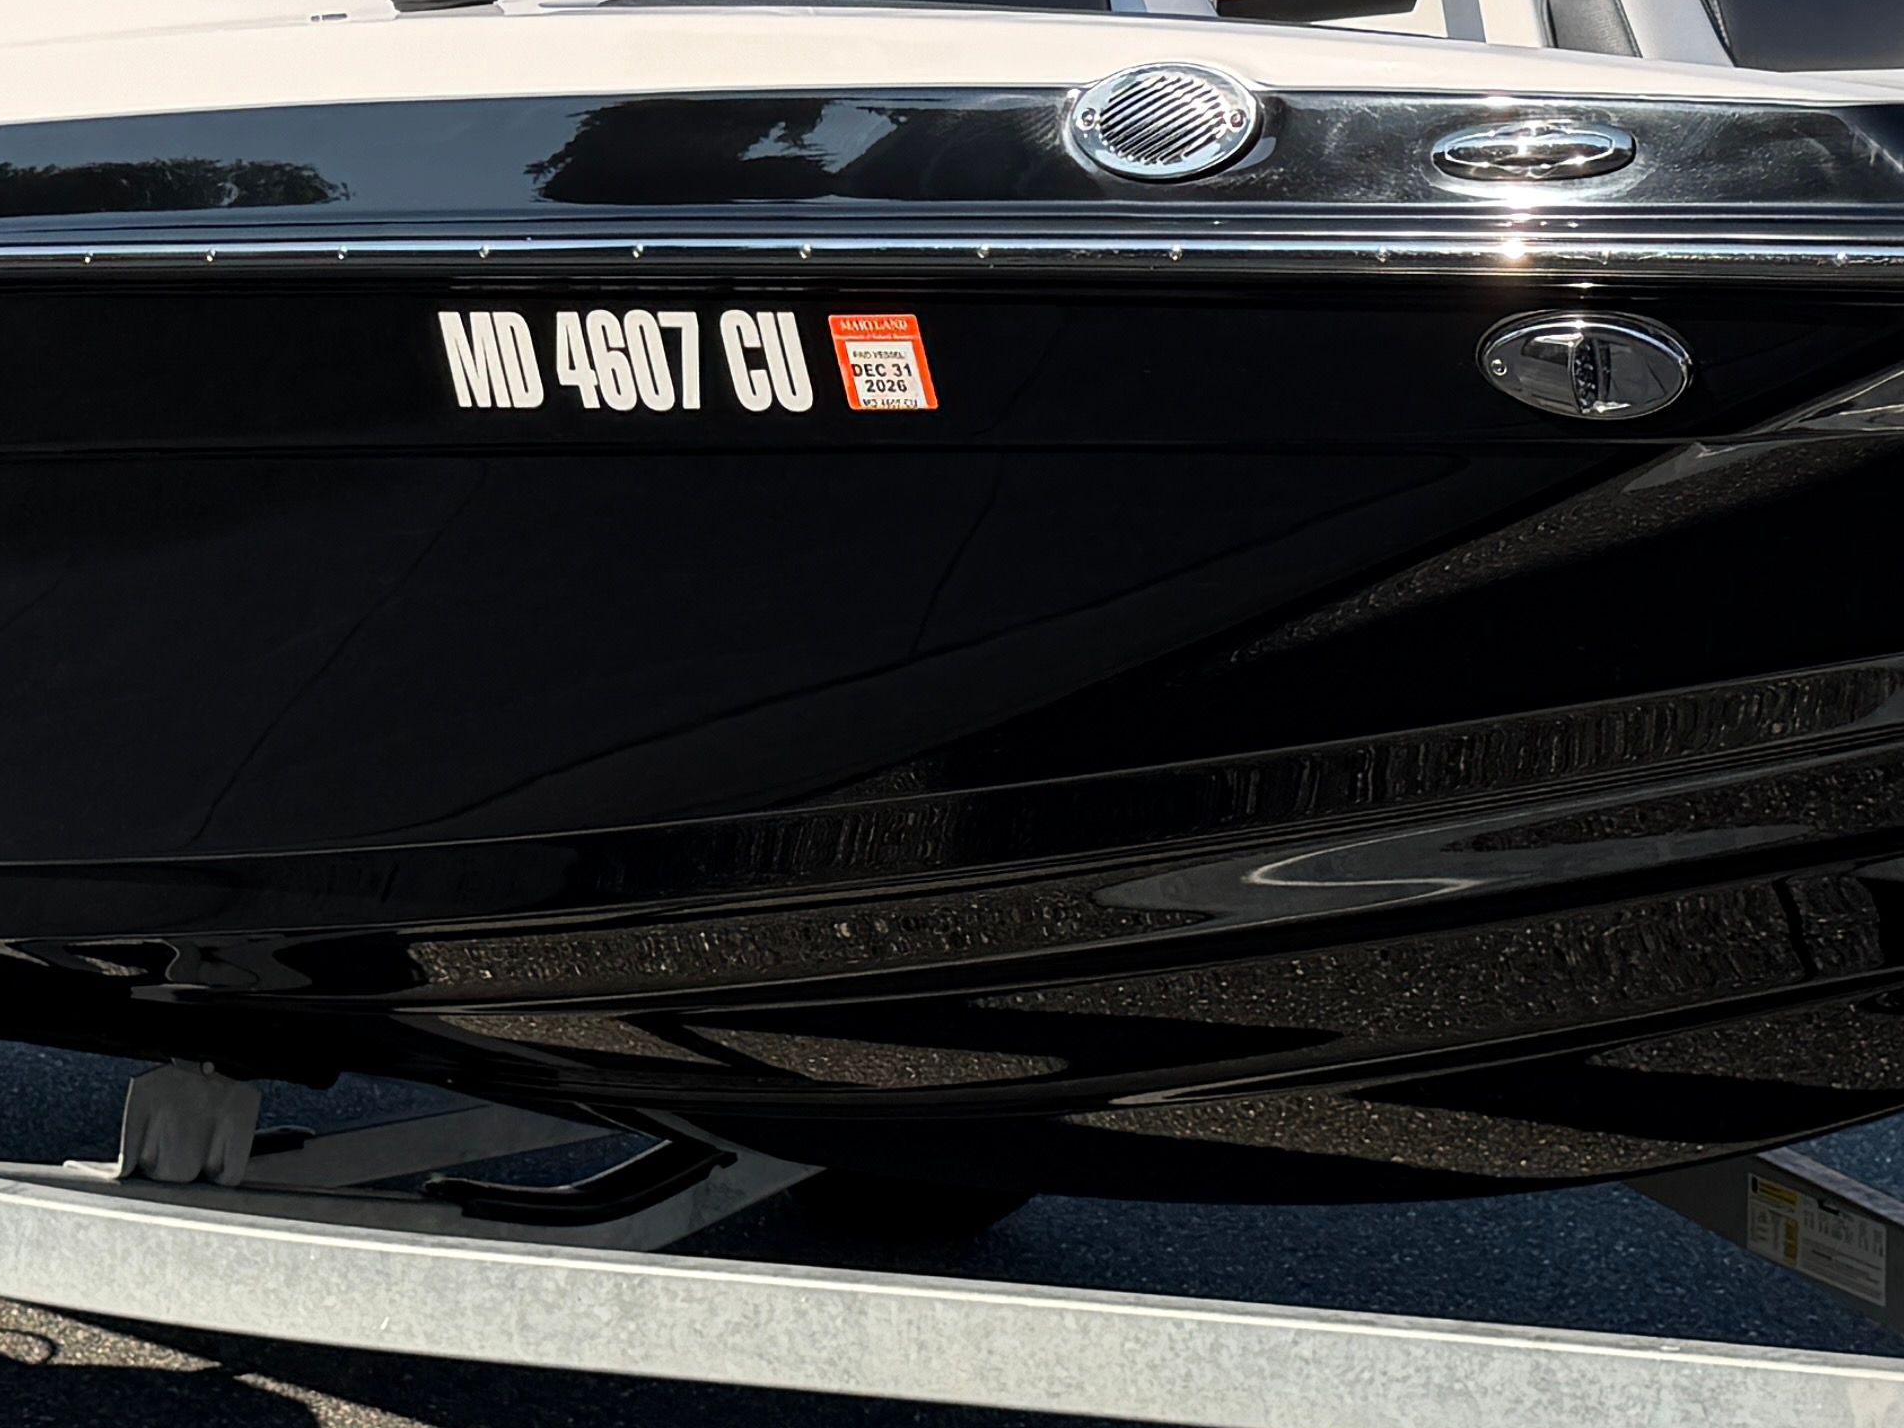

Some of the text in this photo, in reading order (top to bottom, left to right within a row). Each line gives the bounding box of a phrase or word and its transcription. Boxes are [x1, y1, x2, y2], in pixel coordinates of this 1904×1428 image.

[840, 319, 909, 331] MARYLAND
[437, 309, 814, 413] MD 4607 CU
[851, 363, 913, 378] DEC 31
[865, 379, 908, 393] 2026
